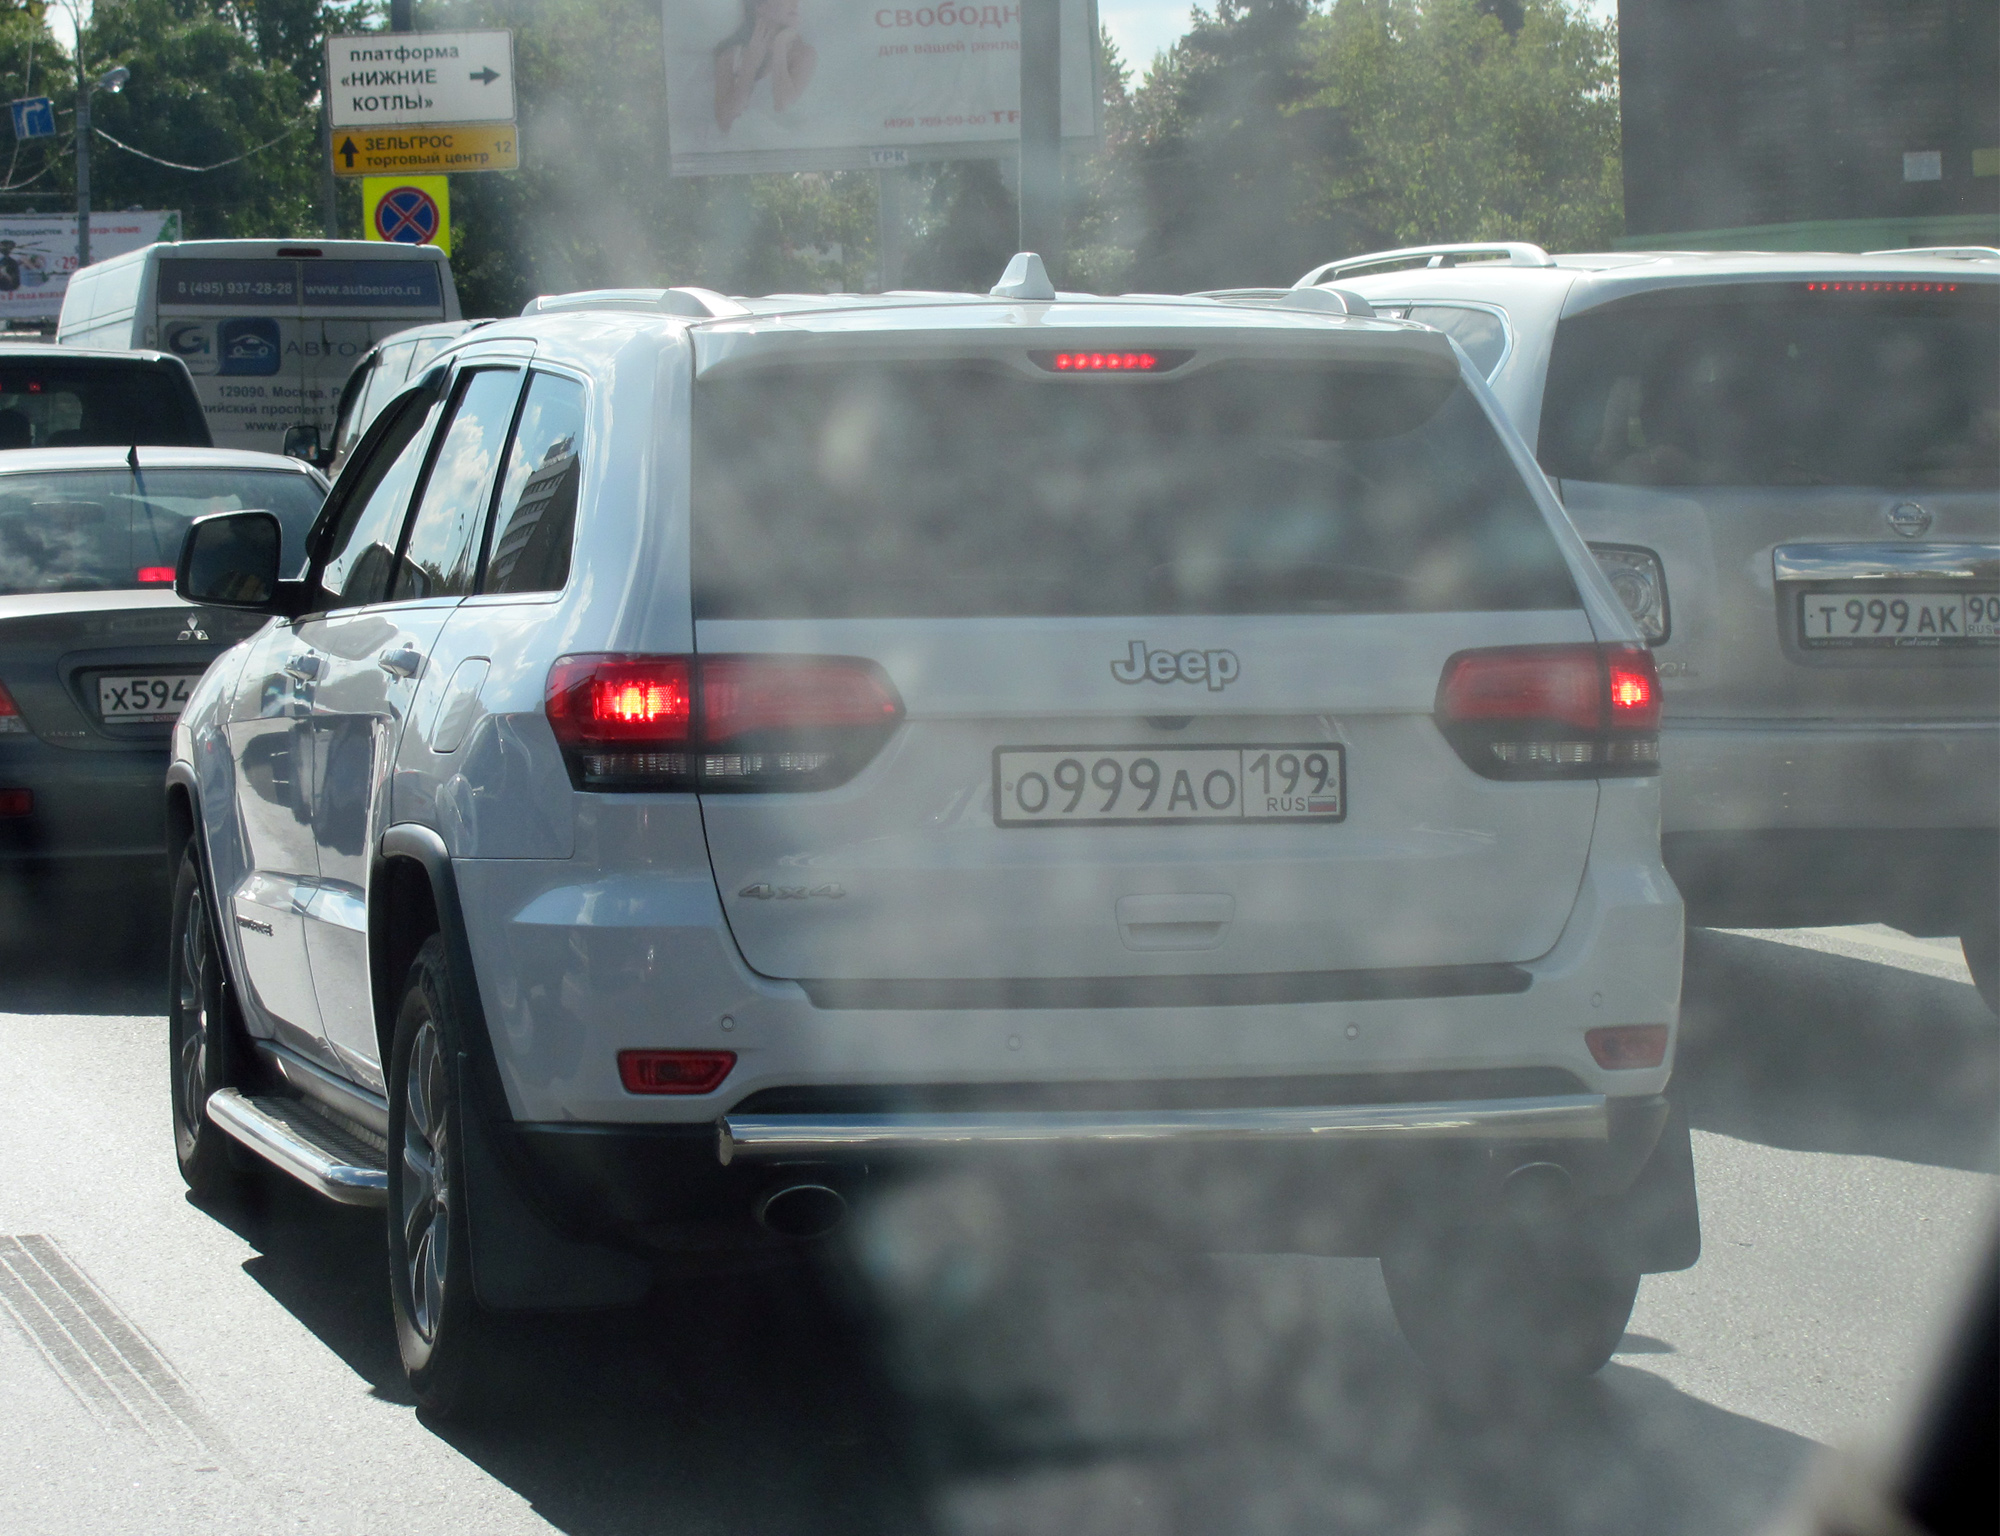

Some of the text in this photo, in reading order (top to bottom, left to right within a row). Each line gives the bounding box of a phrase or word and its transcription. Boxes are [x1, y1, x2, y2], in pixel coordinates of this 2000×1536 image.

[350, 45, 460, 63] платформа
[914, 40, 966, 54] вашей
[341, 69, 438, 87] «НИЖНИЕ
[353, 95, 434, 112] КОТЛЫ»
[365, 134, 454, 151] ЗЕЛЬГРОС
[494, 141, 512, 153] 12
[367, 151, 490, 168] торговый центр
[178, 281, 293, 296] 8 (495) 937-28-28
[305, 282, 422, 296] www.autoeuro.ru
[262, 404, 325, 416] проспект
[1968, 623, 1993, 634] RUS
[1110, 640, 1240, 692] Jeep
[1249, 752, 1329, 795] 199
[1266, 796, 1306, 813] RUS
[738, 882, 846, 900] 4x4
